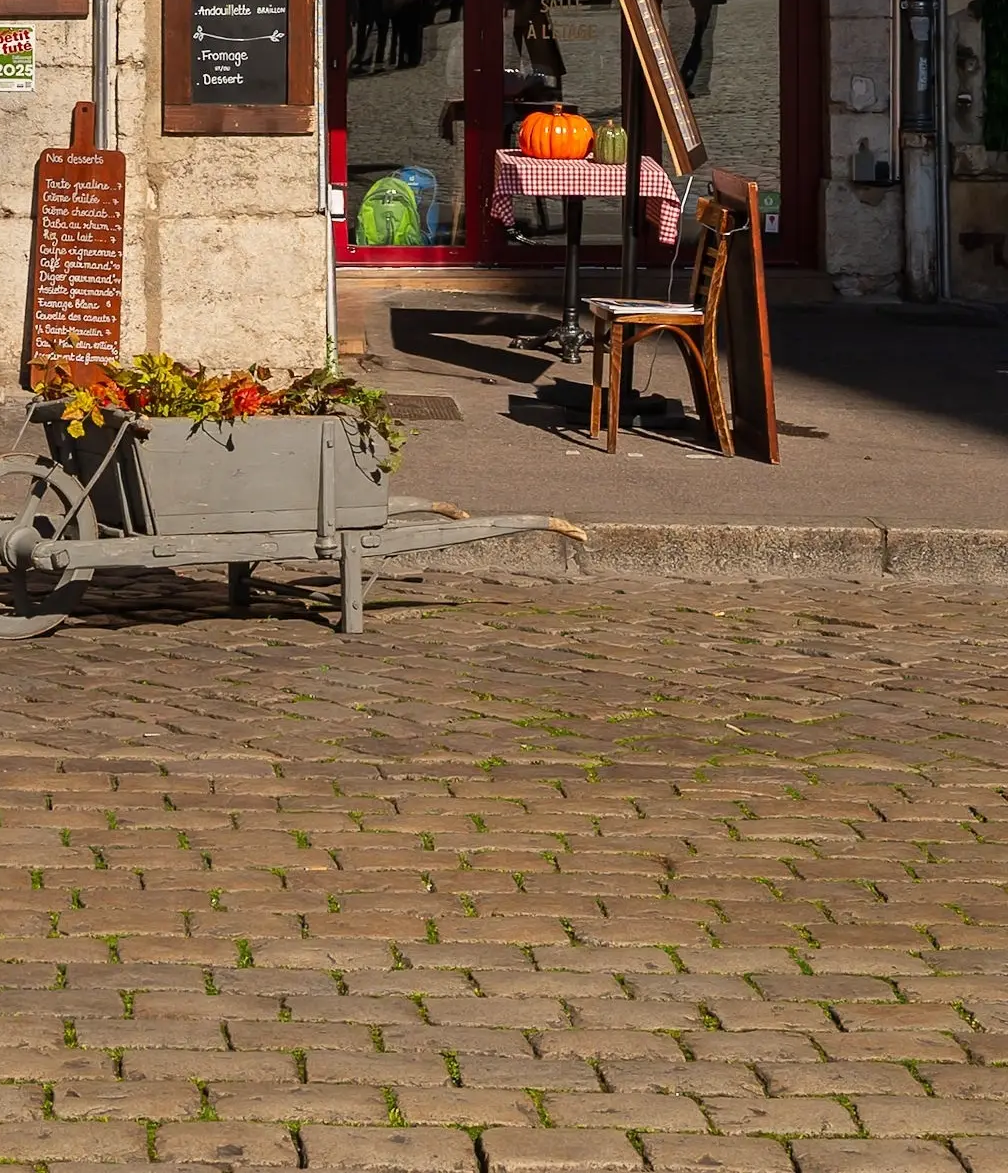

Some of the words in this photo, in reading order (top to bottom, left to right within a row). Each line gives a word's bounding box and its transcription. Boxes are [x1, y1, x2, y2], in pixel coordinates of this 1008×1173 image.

[198, 4, 252, 16] Andouillette
[526, 20, 537, 40] À
[2, 41, 33, 54] futé
[201, 50, 249, 67] Fromage
[202, 74, 244, 86] Dessert
[45, 153, 64, 164] Nos
[67, 153, 105, 165] desserts
[45, 178, 71, 190] Tarte
[73, 179, 110, 195] praline
[42, 216, 68, 229] Baba
[61, 233, 76, 242] au
[77, 231, 94, 242] lait
[40, 257, 61, 272] Café
